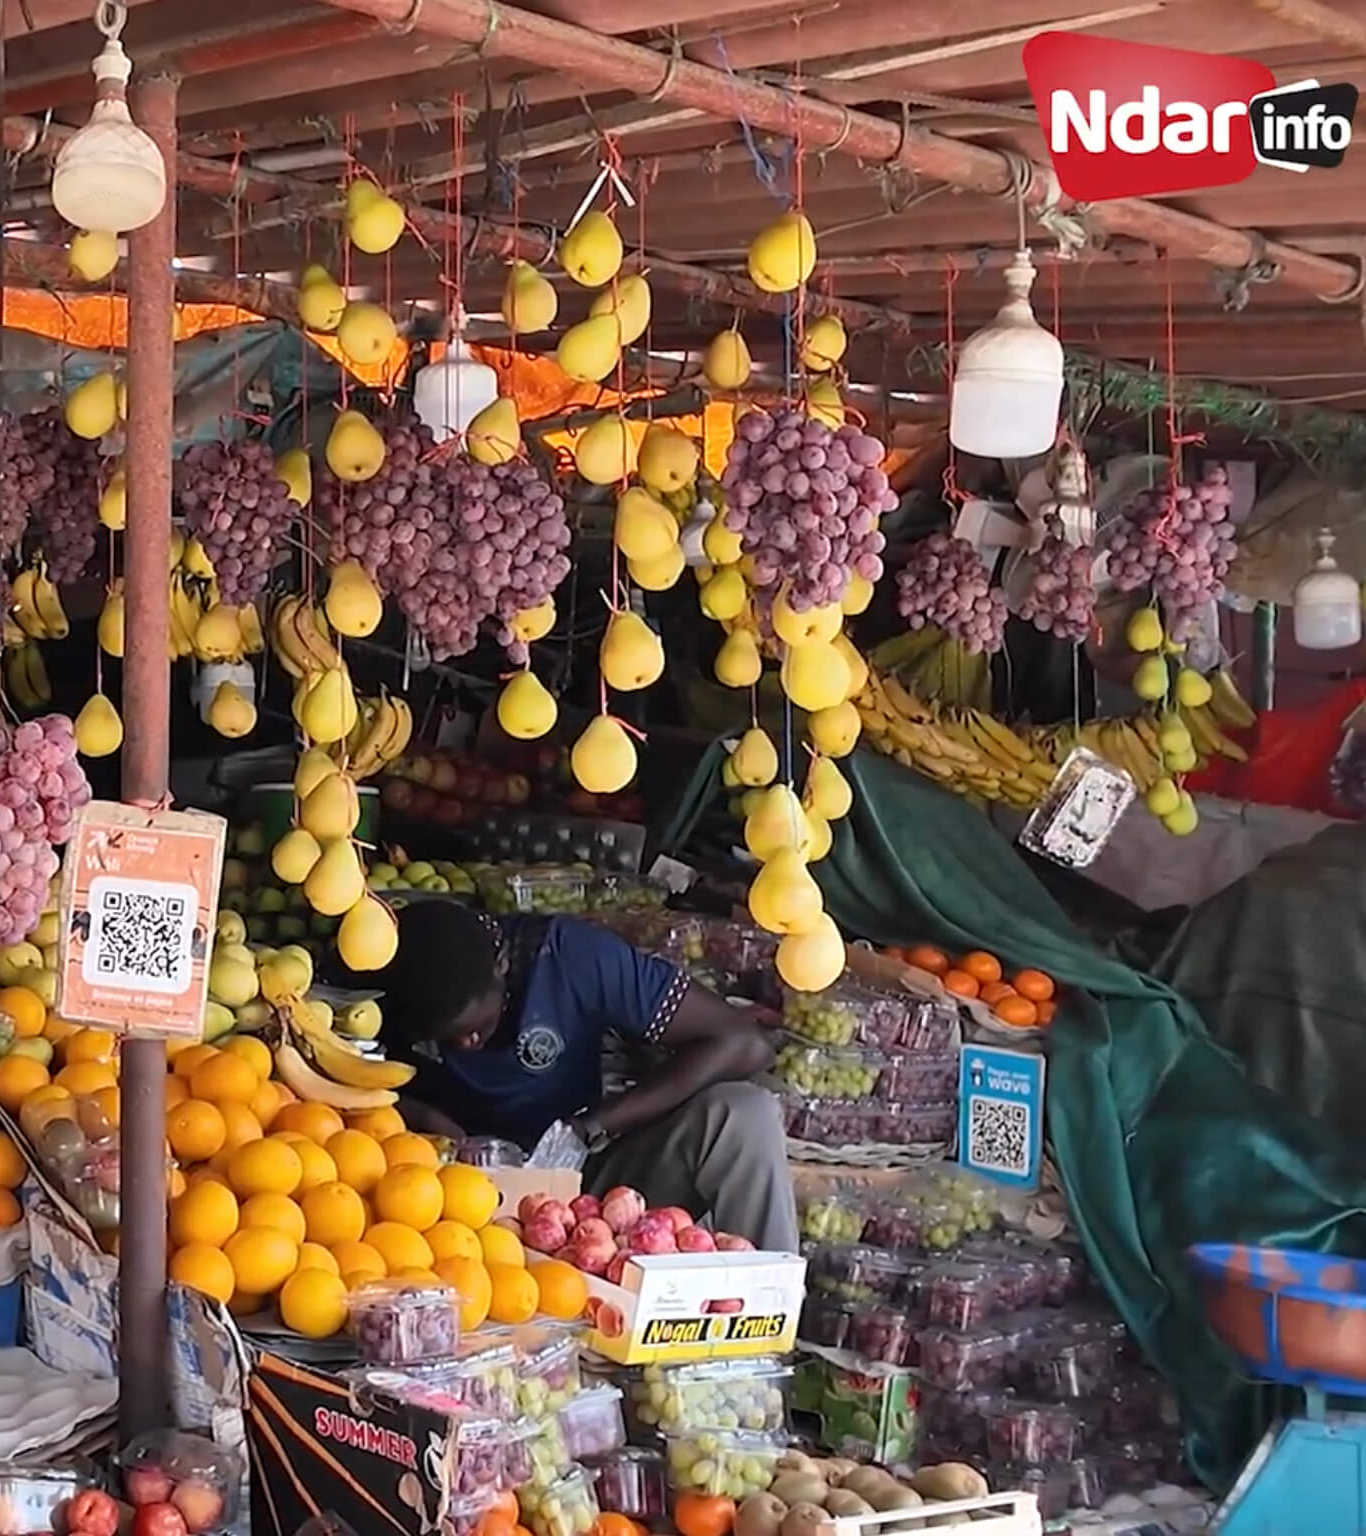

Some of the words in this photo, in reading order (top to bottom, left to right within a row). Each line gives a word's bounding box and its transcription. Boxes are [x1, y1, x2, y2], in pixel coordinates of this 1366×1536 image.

[987, 1076, 1031, 1095] wave
[647, 1318, 705, 1347] Nogal
[732, 1315, 783, 1338] Fruits
[313, 1406, 418, 1471] SUMMER
